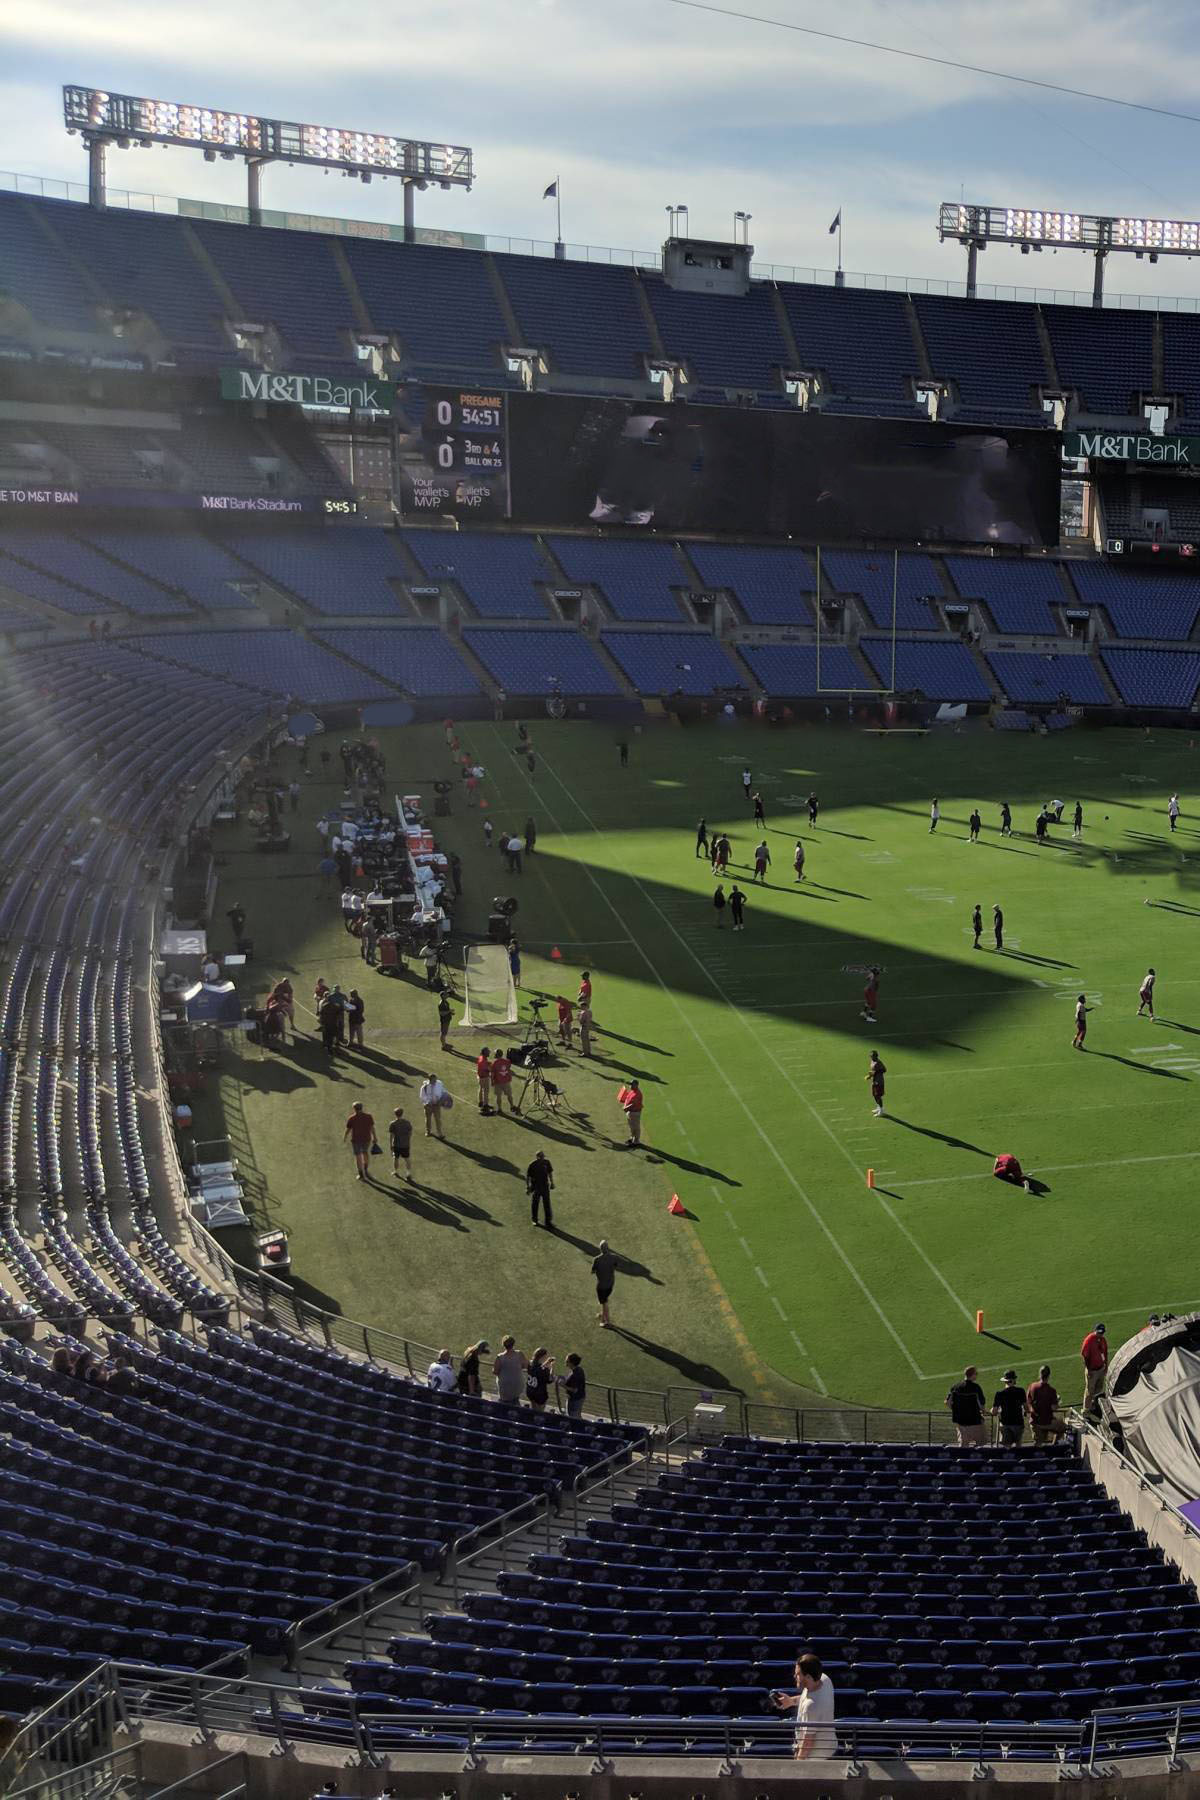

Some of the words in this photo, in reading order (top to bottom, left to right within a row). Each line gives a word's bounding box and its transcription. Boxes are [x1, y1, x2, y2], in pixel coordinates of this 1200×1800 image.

[239, 371, 311, 402] M&T
[314, 377, 380, 407] Bank
[460, 395, 502, 408] PREGAME
[437, 401, 452, 425] 0
[462, 409, 500, 426] 54:51
[465, 440, 482, 454] 3RD
[1078, 434, 1135, 459] M&T
[1136, 439, 1190, 462] Bank
[438, 443, 454, 468] 0
[412, 478, 435, 487] Your
[11, 490, 25, 502] TO
[28, 490, 51, 503] M&T
[55, 491, 78, 503] BAN
[413, 487, 449, 498] wallet's
[202, 496, 230, 509] M&T
[230, 497, 256, 510] Bank
[257, 498, 301, 512] Stadium
[325, 501, 357, 513] 54:51
